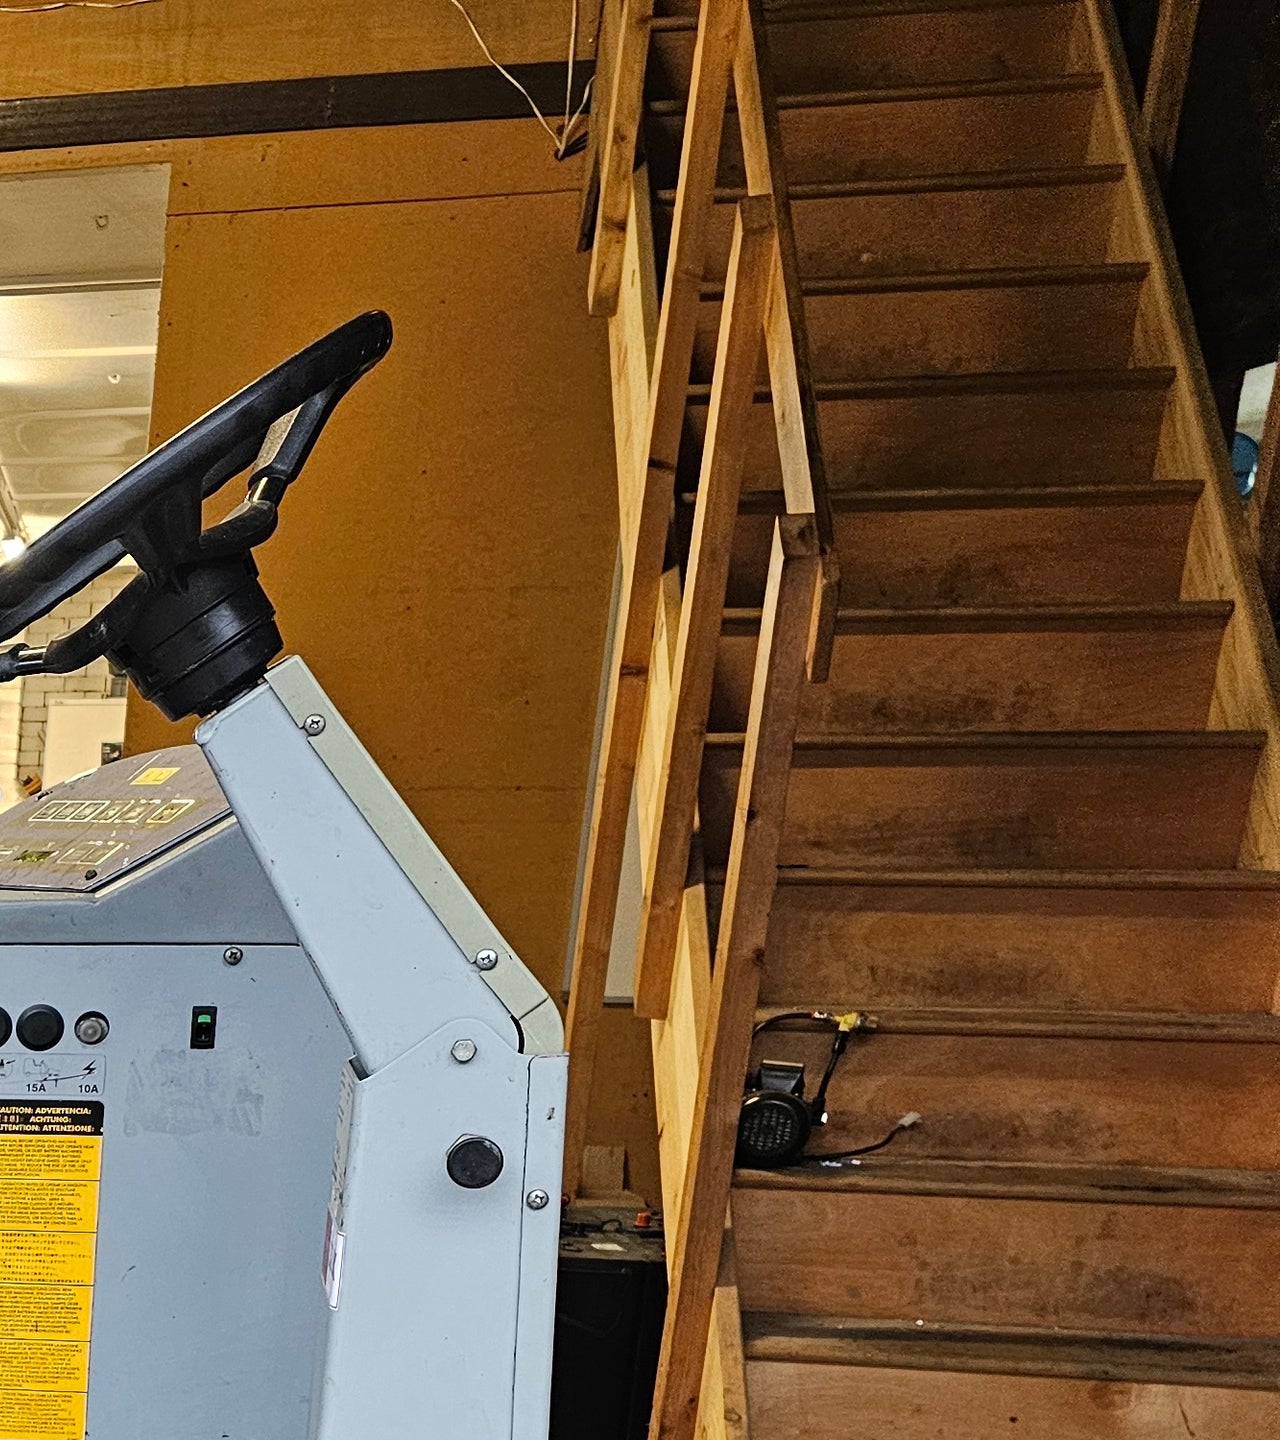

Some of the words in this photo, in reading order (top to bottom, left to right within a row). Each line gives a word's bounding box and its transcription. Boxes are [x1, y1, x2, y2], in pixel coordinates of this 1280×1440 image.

[25, 1083, 46, 1092] 15A
[78, 1084, 99, 1093] 10A
[35, 1107, 92, 1115] ADVERTENCIA:
